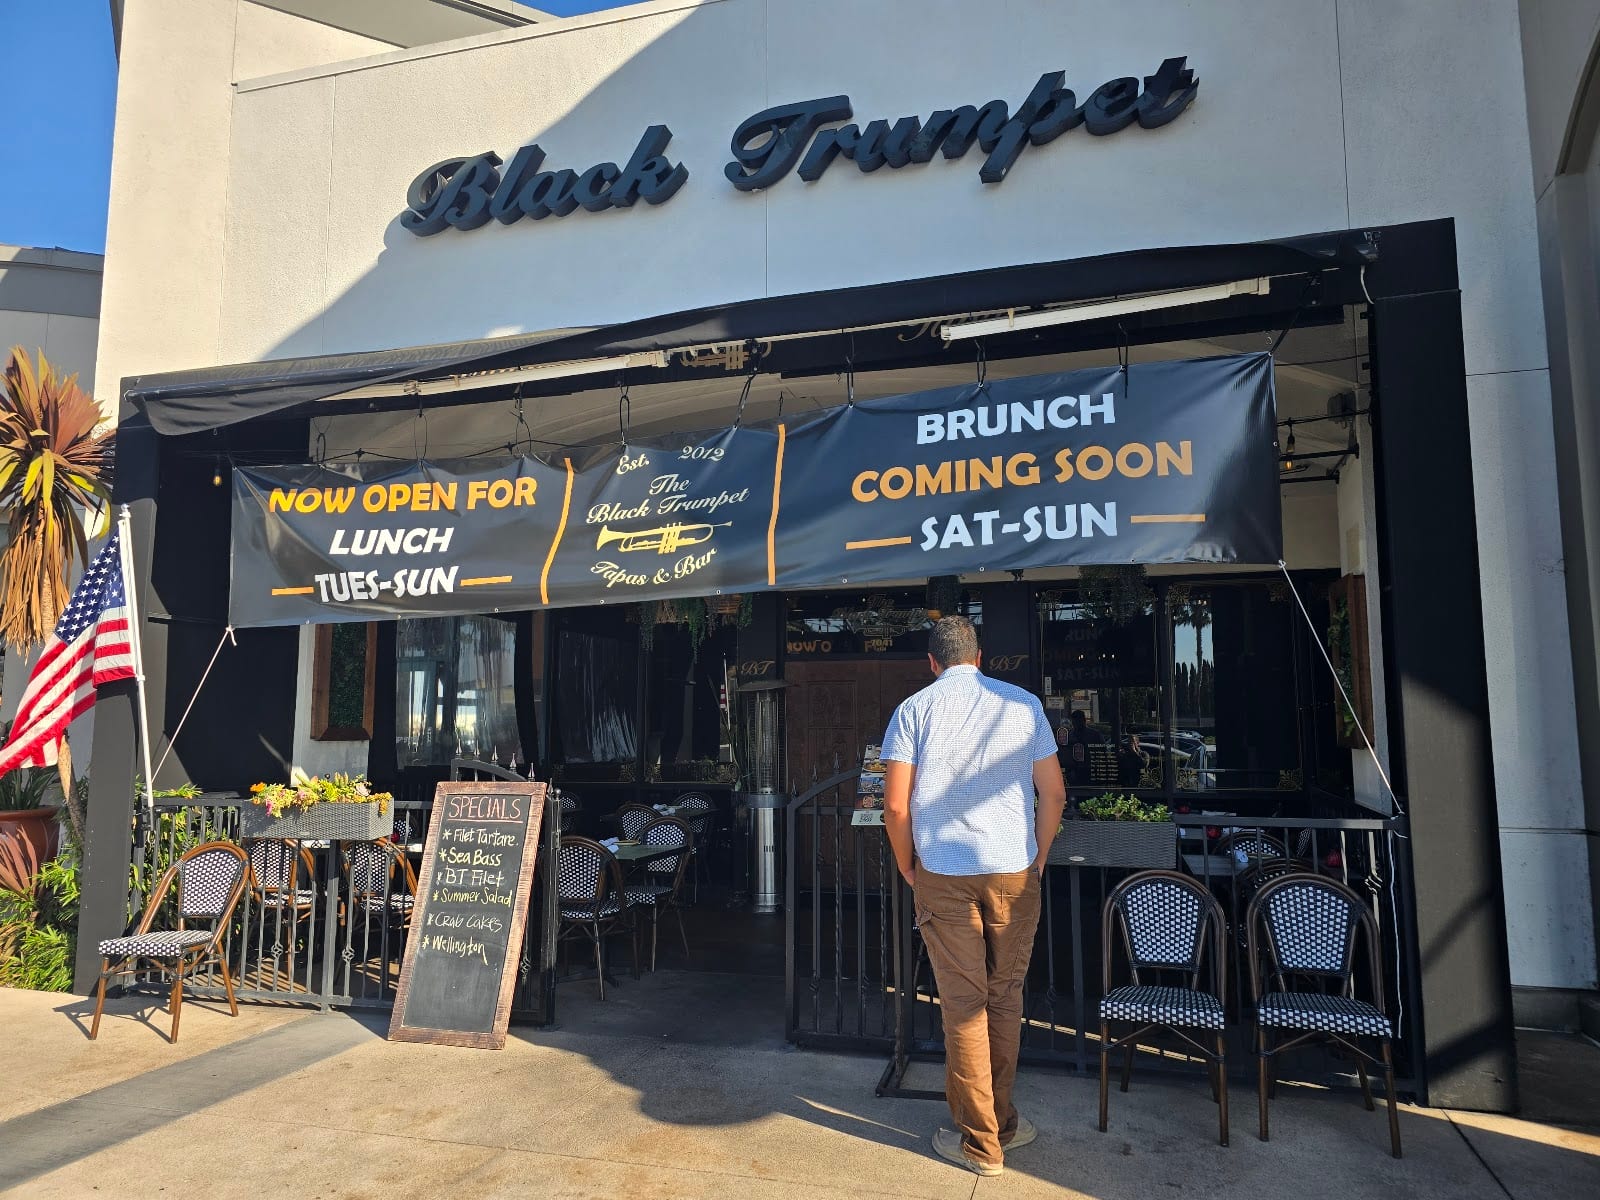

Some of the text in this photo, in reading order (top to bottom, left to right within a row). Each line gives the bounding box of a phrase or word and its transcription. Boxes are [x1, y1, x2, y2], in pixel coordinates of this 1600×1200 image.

[400, 56, 1200, 237] Black Trumpet
[917, 392, 1117, 446] BRUNCH
[615, 445, 725, 475] Est. 2012
[851, 440, 1194, 503] COMING SOON
[268, 477, 537, 514] NOW OPEN FOR
[648, 473, 693, 495] The
[585, 487, 751, 524] Black Trumpet
[328, 527, 454, 556] LUNCH
[920, 501, 1119, 552] SAT-SUN
[590, 547, 718, 588] Tapas & Bar
[314, 565, 460, 603] TUES-SUN
[450, 797, 521, 818] SPECIALS
[453, 828, 475, 843] Filet
[447, 847, 503, 867] Sea Bass
[445, 867, 505, 887] BT Filet
[440, 888, 513, 907] Summer Salad
[432, 935, 489, 966] Wellington
